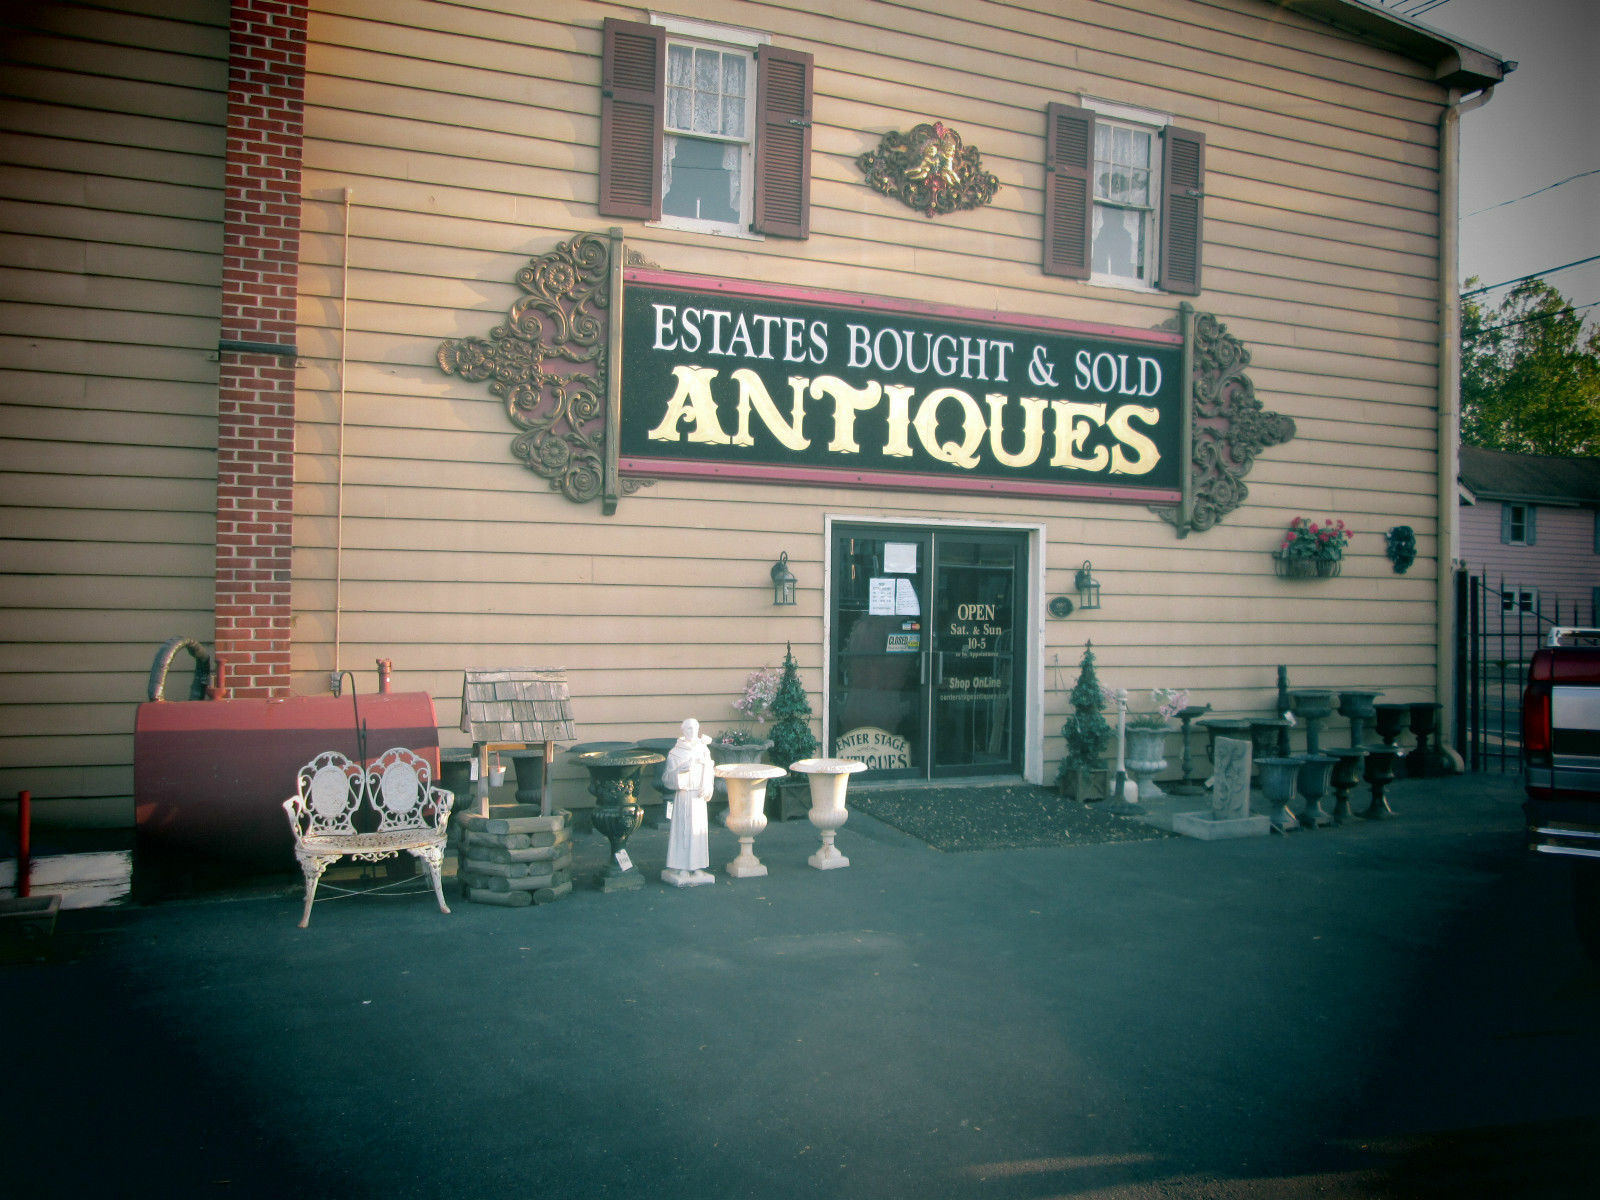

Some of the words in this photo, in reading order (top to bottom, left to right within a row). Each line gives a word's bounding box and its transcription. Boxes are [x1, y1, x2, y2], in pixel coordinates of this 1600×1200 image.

[651, 303, 829, 365] ESTATES
[846, 324, 1014, 382] BOUGHT
[1028, 345, 1059, 387] &
[1075, 350, 1163, 397] SOLD
[647, 364, 1162, 476] ANTIQUES
[957, 603, 996, 621] OPEN
[950, 623, 969, 635] Sat.
[972, 626, 980, 635] &
[983, 623, 1002, 635] Sun
[967, 637, 987, 650] 10-5
[949, 677, 971, 691] Shop
[973, 677, 1002, 688] OnLine
[874, 733, 906, 753] STAGE
[839, 754, 908, 769] IQUES
